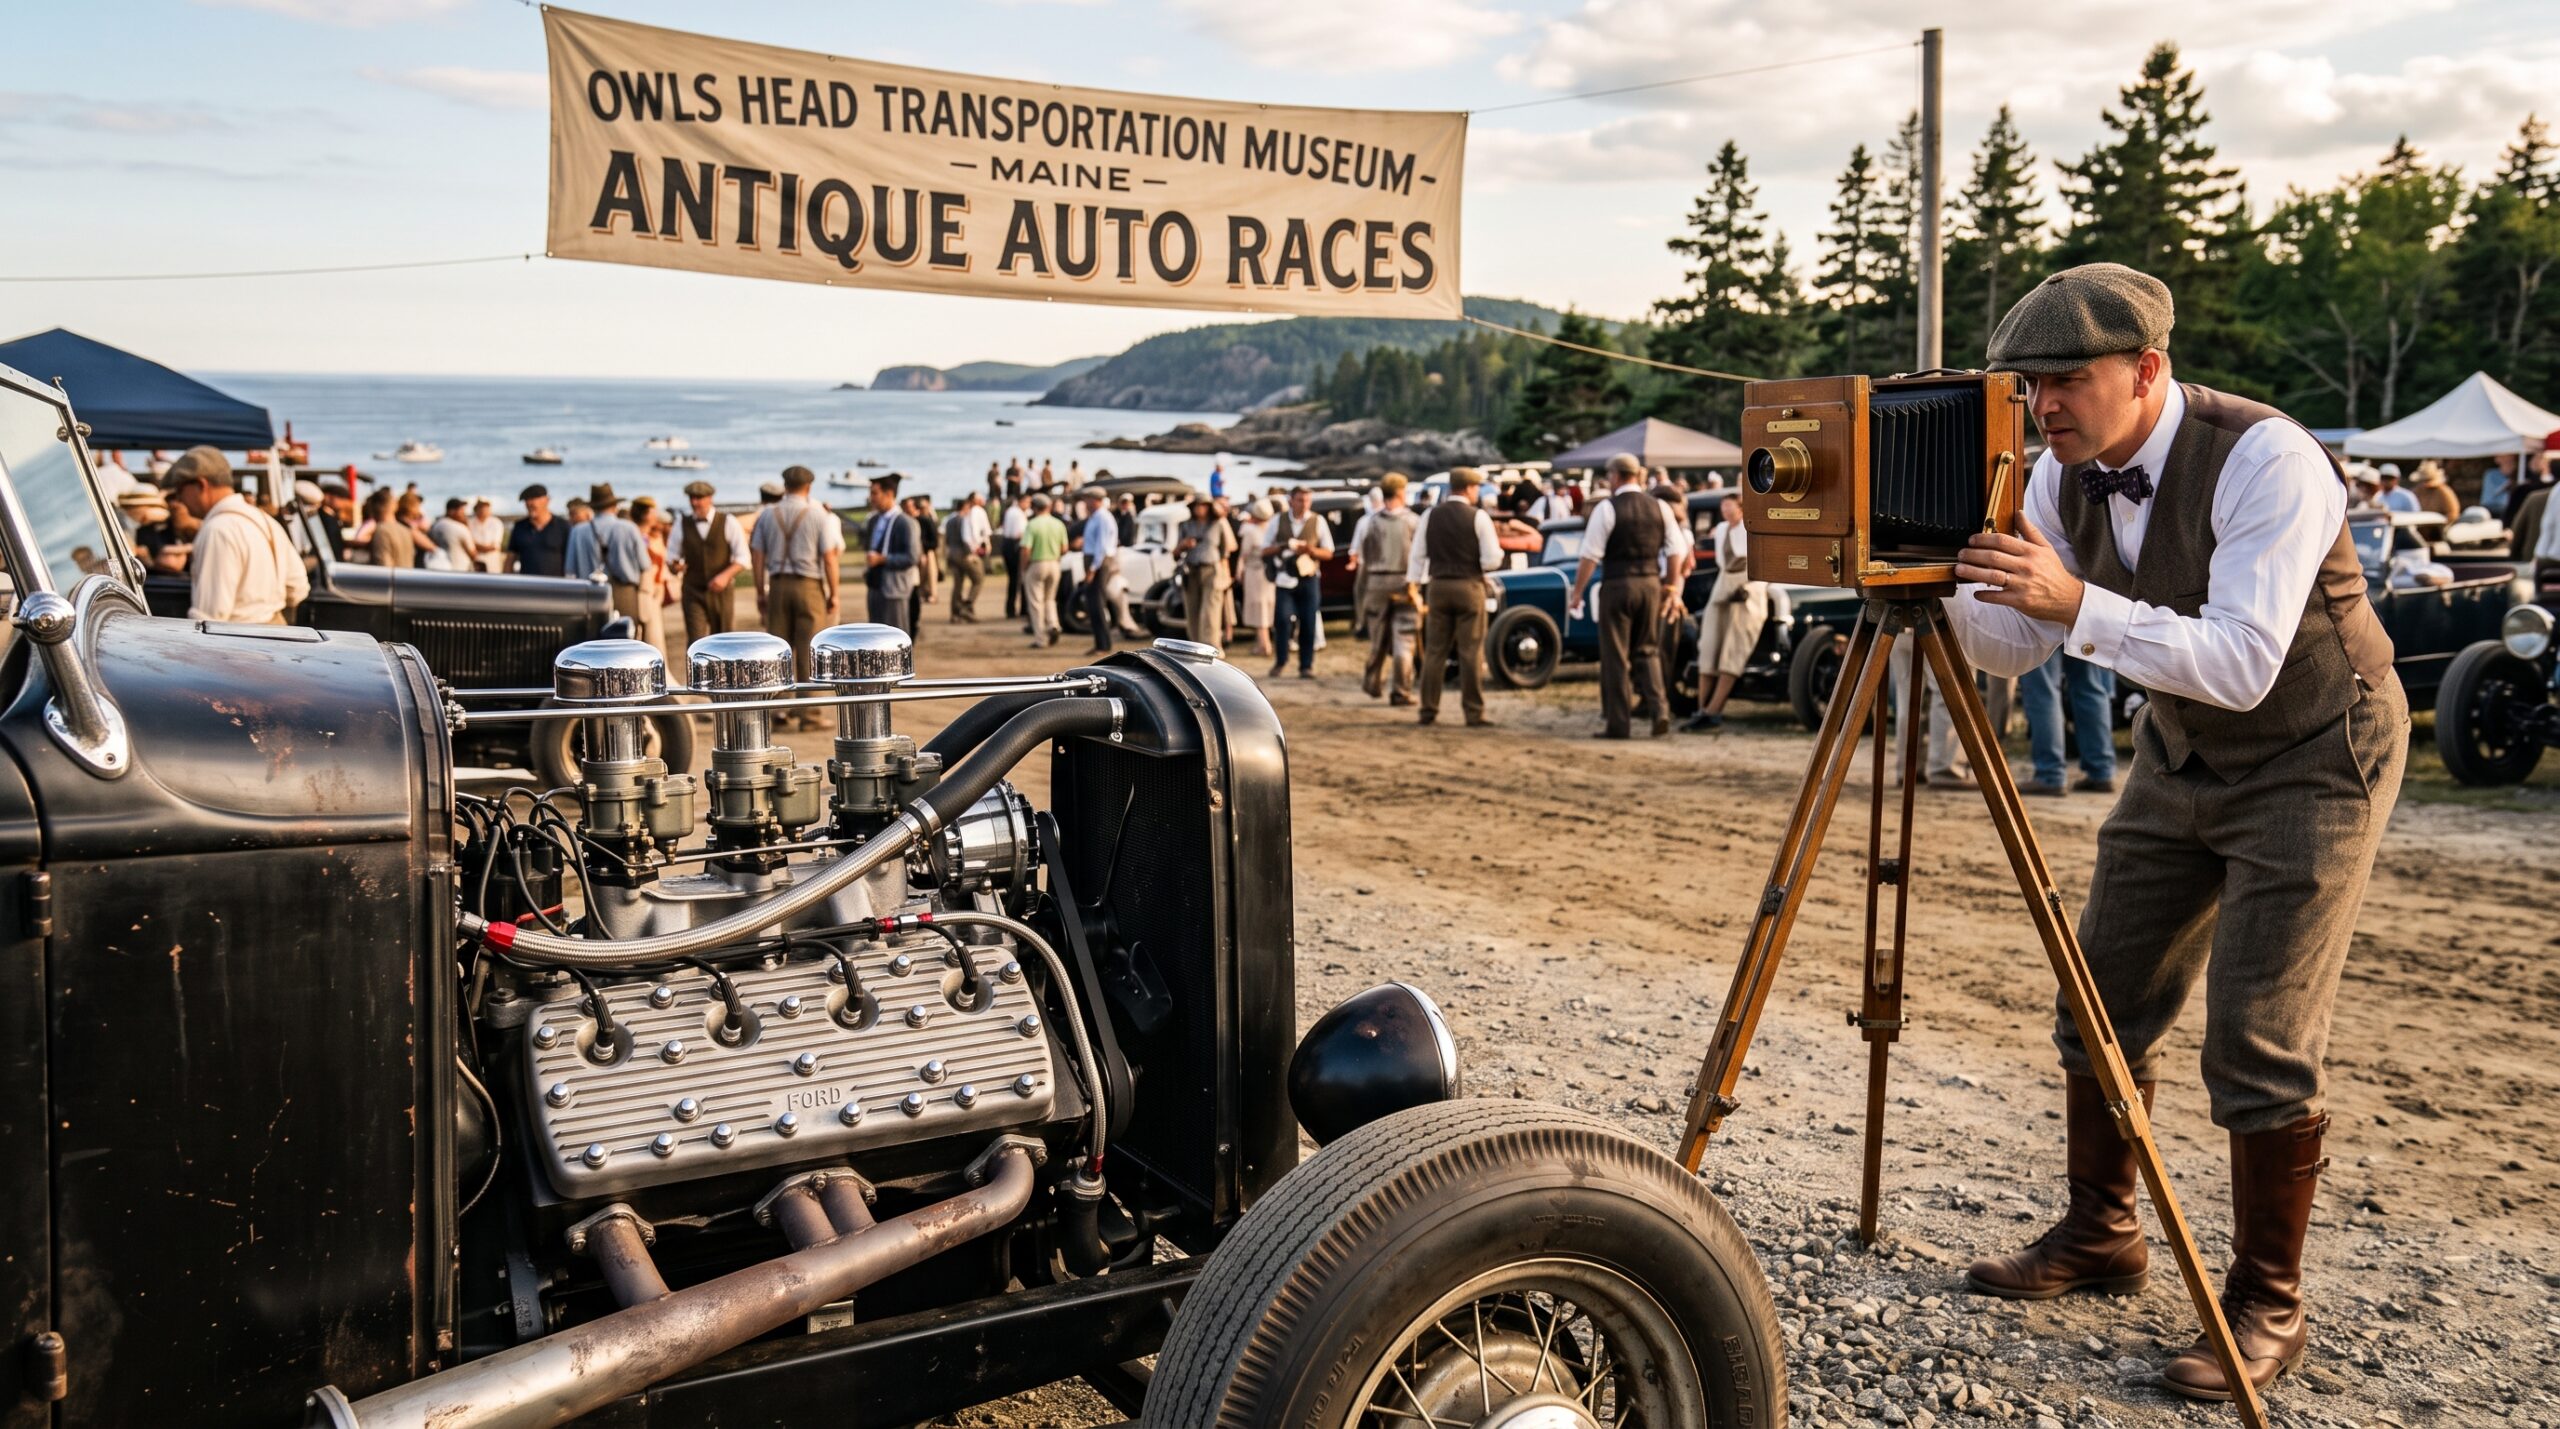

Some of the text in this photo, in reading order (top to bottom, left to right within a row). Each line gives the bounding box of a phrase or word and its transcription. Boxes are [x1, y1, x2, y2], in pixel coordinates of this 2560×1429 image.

[588, 69, 722, 122] OWLS
[738, 75, 858, 128] HEAD
[874, 84, 1226, 165] TRANSPORTATION
[589, 149, 1438, 295] ANTIQUE AUTO RACES
[787, 1087, 841, 1111] FORD
